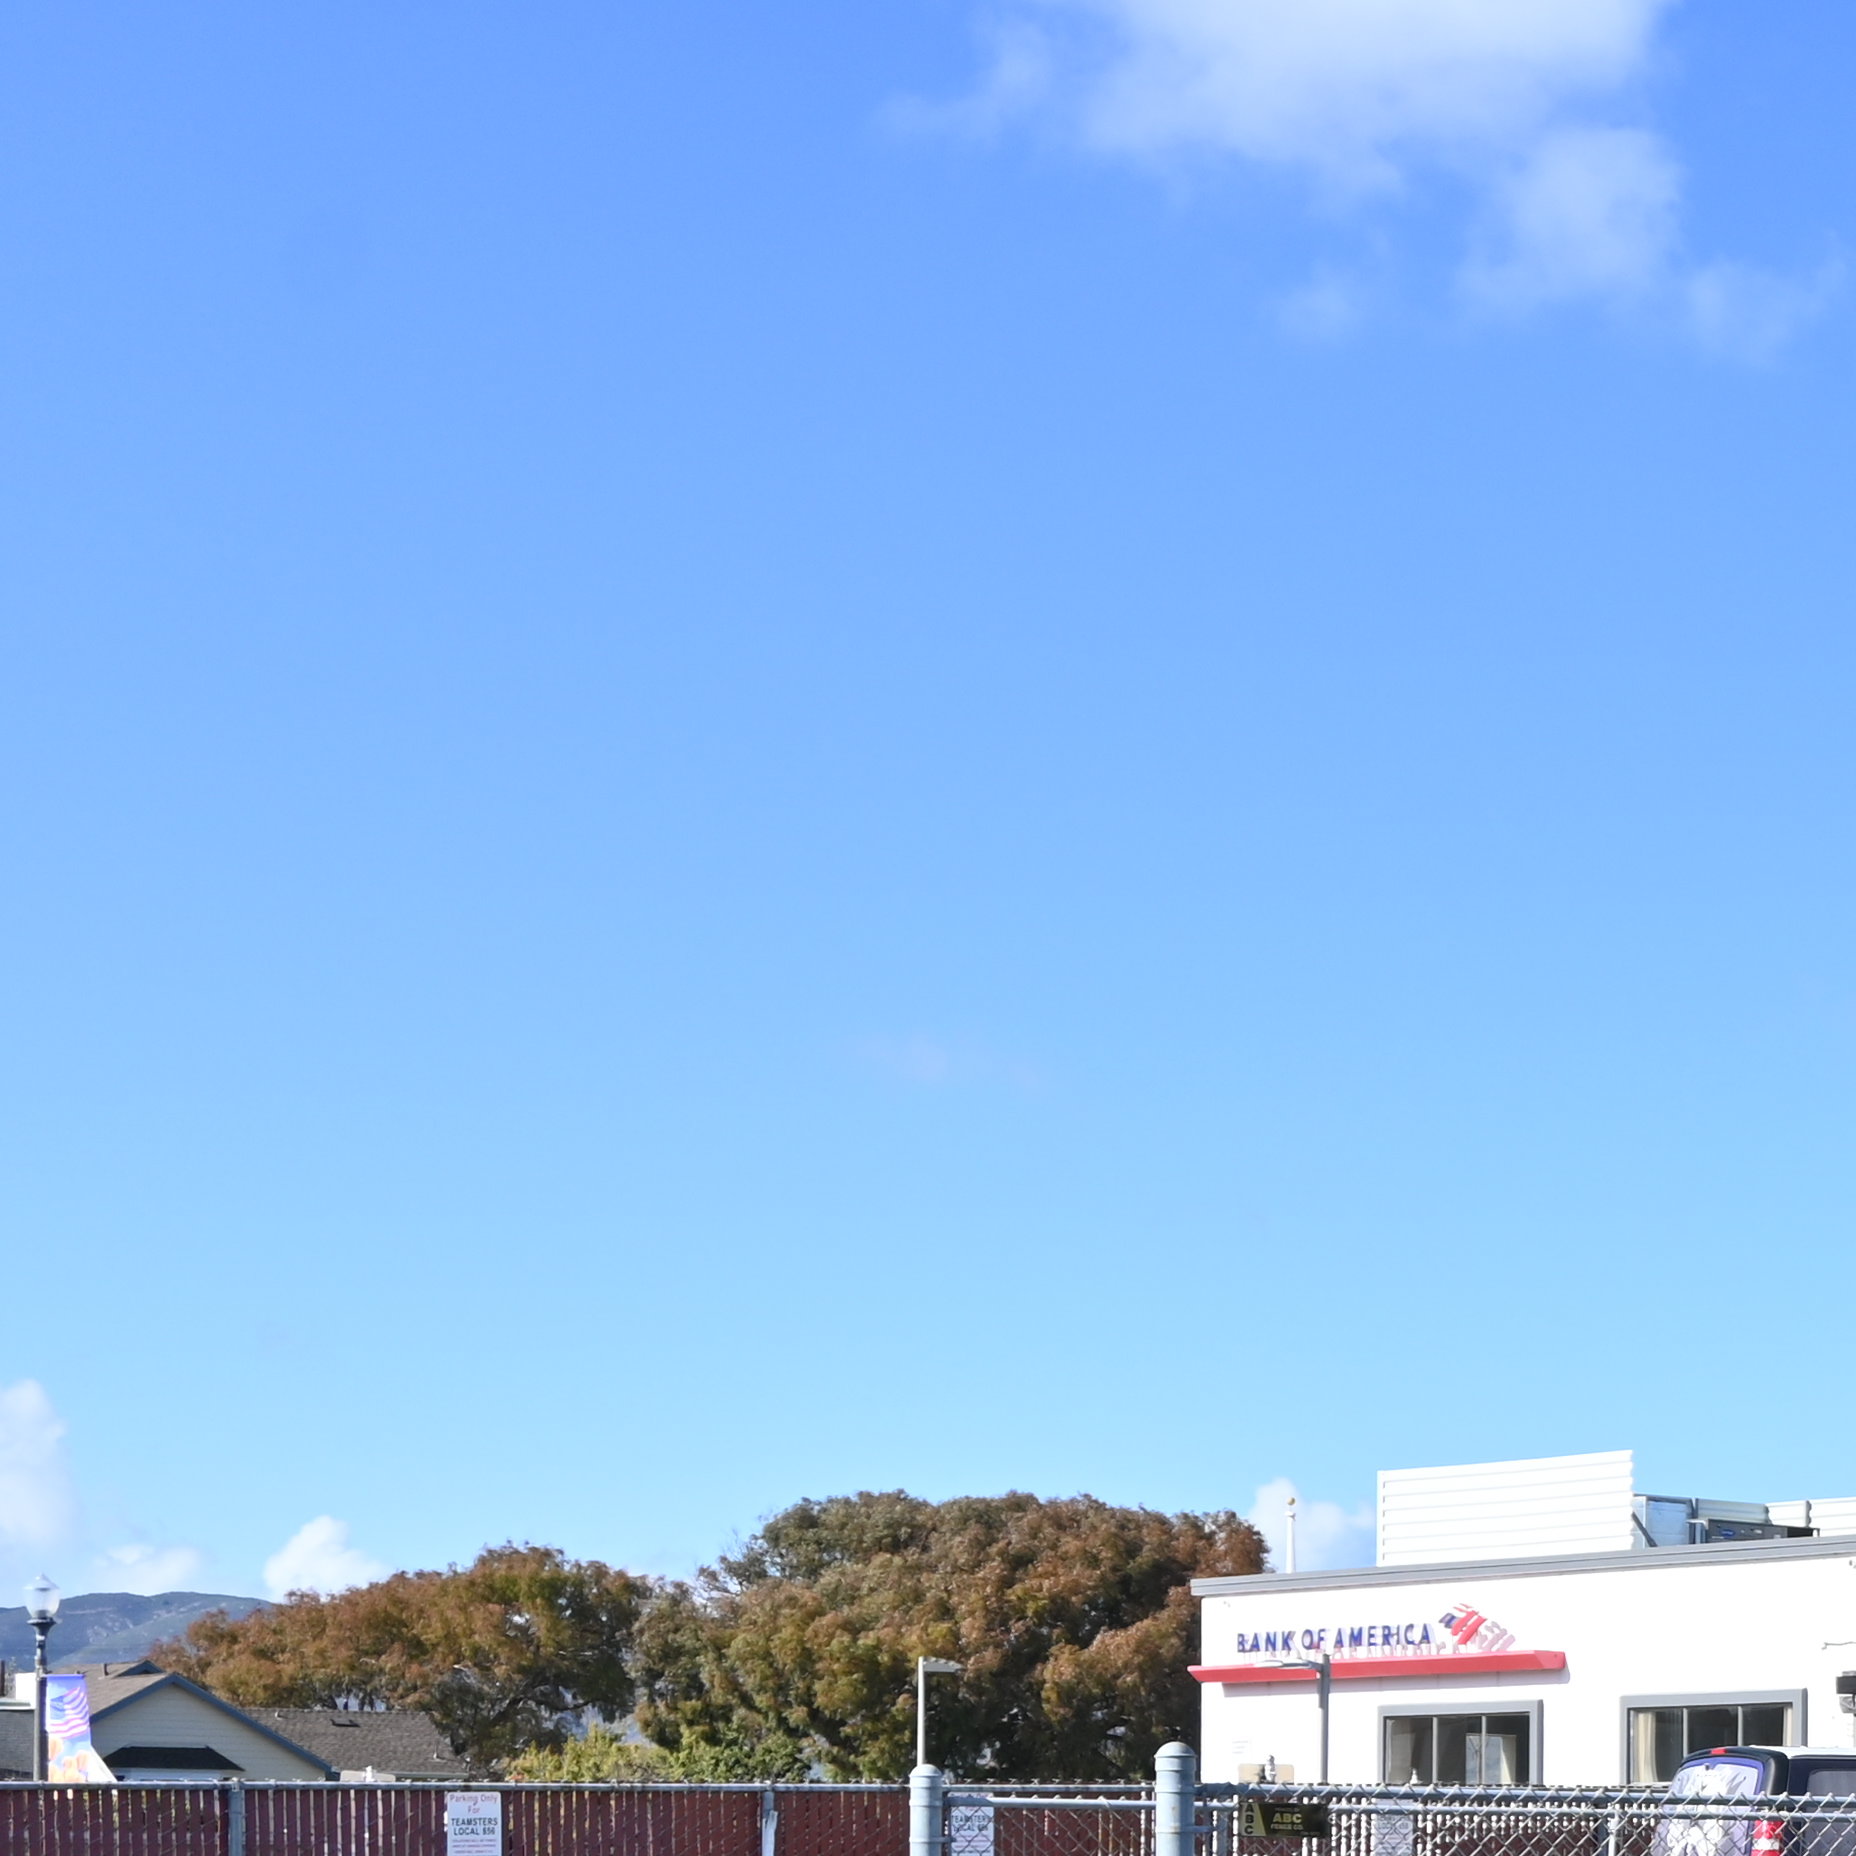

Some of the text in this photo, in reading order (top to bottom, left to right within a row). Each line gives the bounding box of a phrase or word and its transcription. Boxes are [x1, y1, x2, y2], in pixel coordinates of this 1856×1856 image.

[1237, 1623, 1432, 1653] BANK OF AMERICA
[449, 1794, 498, 1806] Parking Only
[468, 1806, 480, 1814] For
[451, 1817, 498, 1827] TEAMSTERS
[1272, 1812, 1303, 1823] ABC
[453, 1827, 480, 1836] LOCAL
